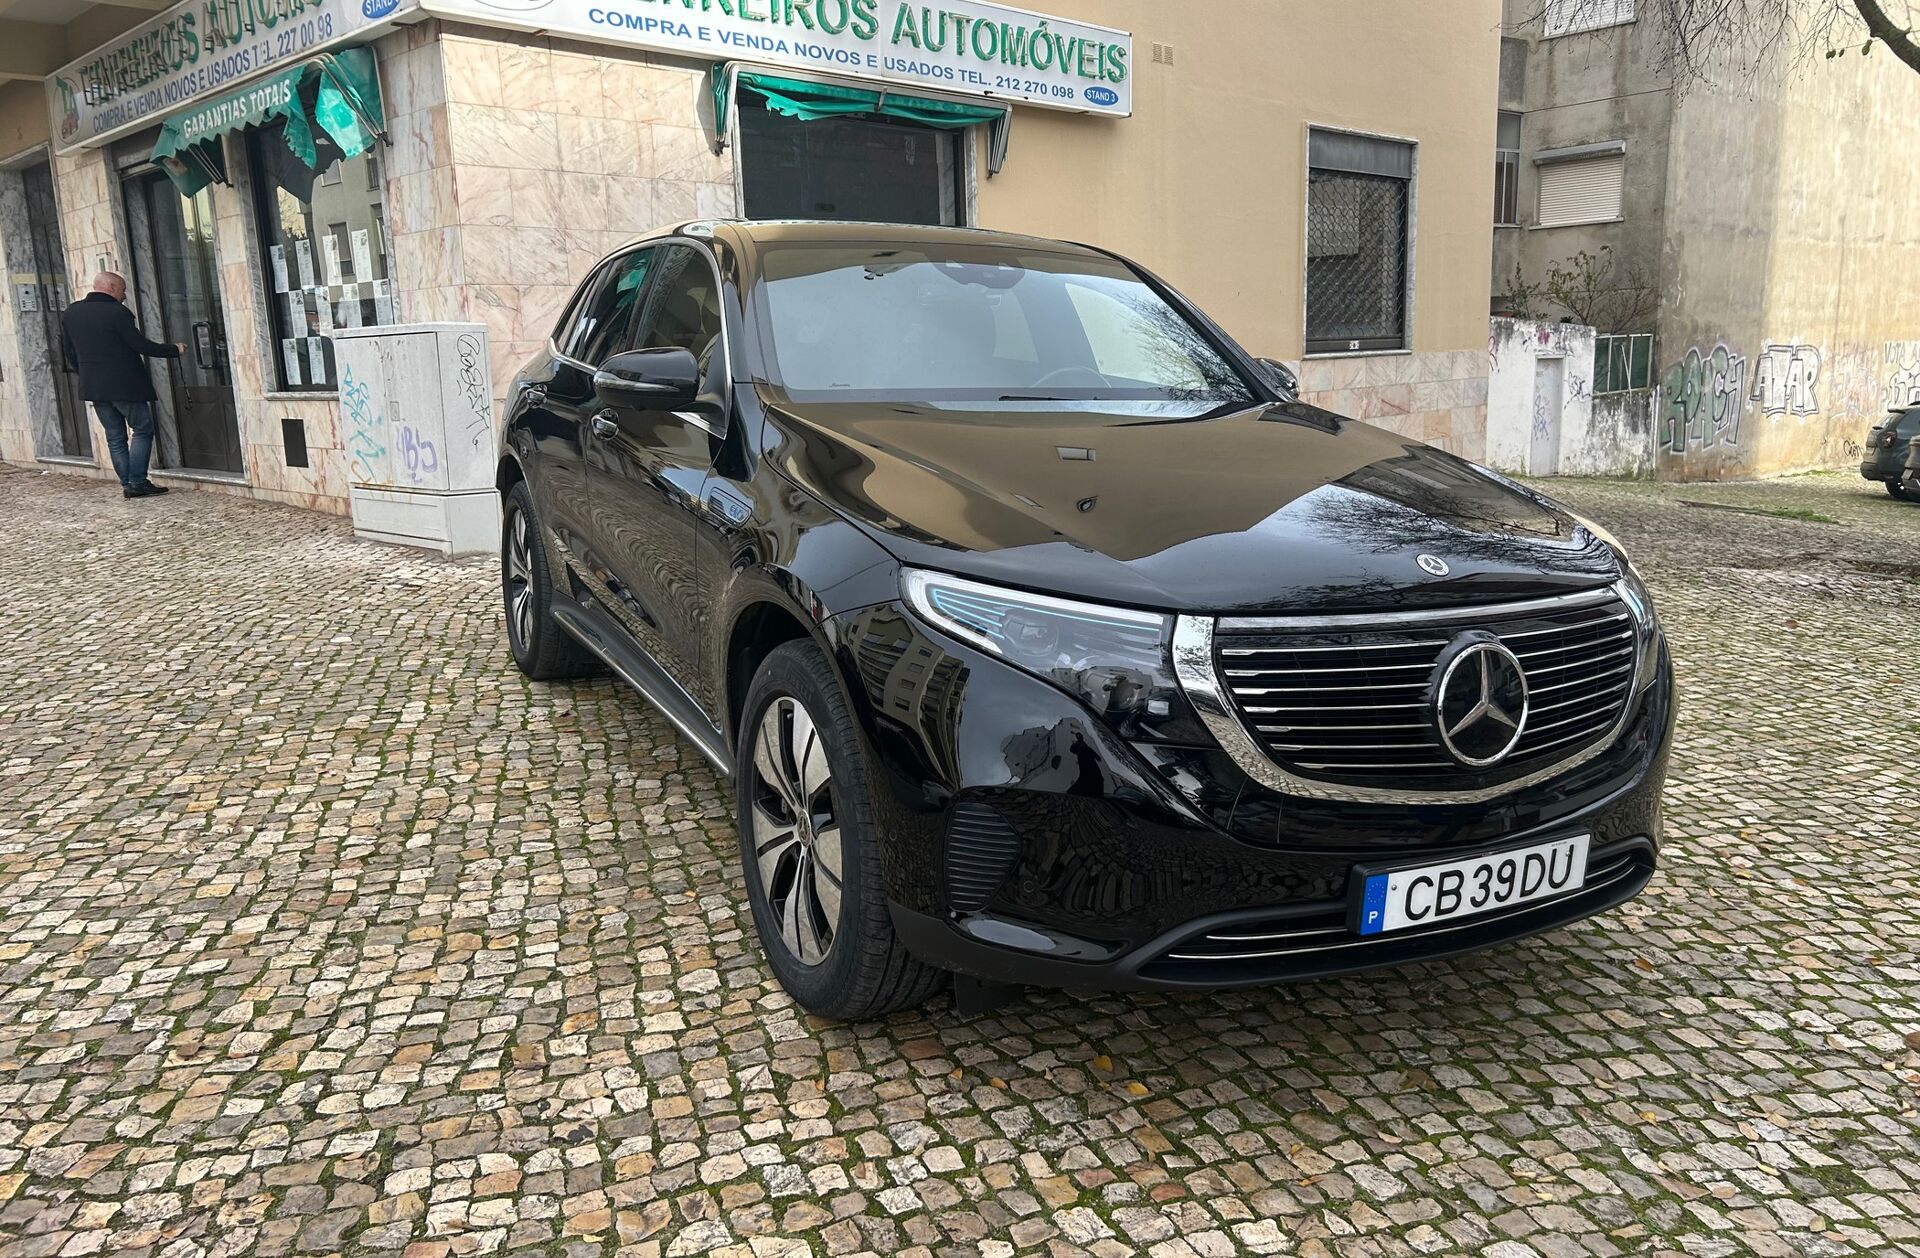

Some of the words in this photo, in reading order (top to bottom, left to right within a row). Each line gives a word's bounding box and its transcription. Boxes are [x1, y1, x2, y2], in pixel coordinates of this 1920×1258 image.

[93, 105, 126, 133] COMPRA
[127, 104, 134, 119] E
[133, 90, 164, 115] VENDA
[164, 72, 197, 106] NOVOS
[199, 67, 206, 90] E
[206, 49, 250, 87] USADOS
[277, 26, 297, 57] 227
[300, 21, 315, 48] 00
[318, 12, 333, 42] 98
[588, 8, 692, 38] COMPRA
[697, 26, 711, 41] E
[717, 29, 789, 54] VENDA
[794, 41, 861, 65] NOVOS
[866, 54, 878, 68] E
[884, 56, 954, 80] USADOS
[958, 69, 992, 86] TEL.
[996, 75, 1020, 91] 212
[1024, 81, 1048, 95] 270
[1051, 85, 1074, 99] 098
[891, 3, 1127, 84] AUTOMÓVEIS
[183, 96, 247, 139] GARANTIAS
[249, 79, 291, 112] TOTAIS
[1086, 89, 1109, 102] STAND
[1109, 94, 1116, 103] 3
[1368, 910, 1379, 925] P
